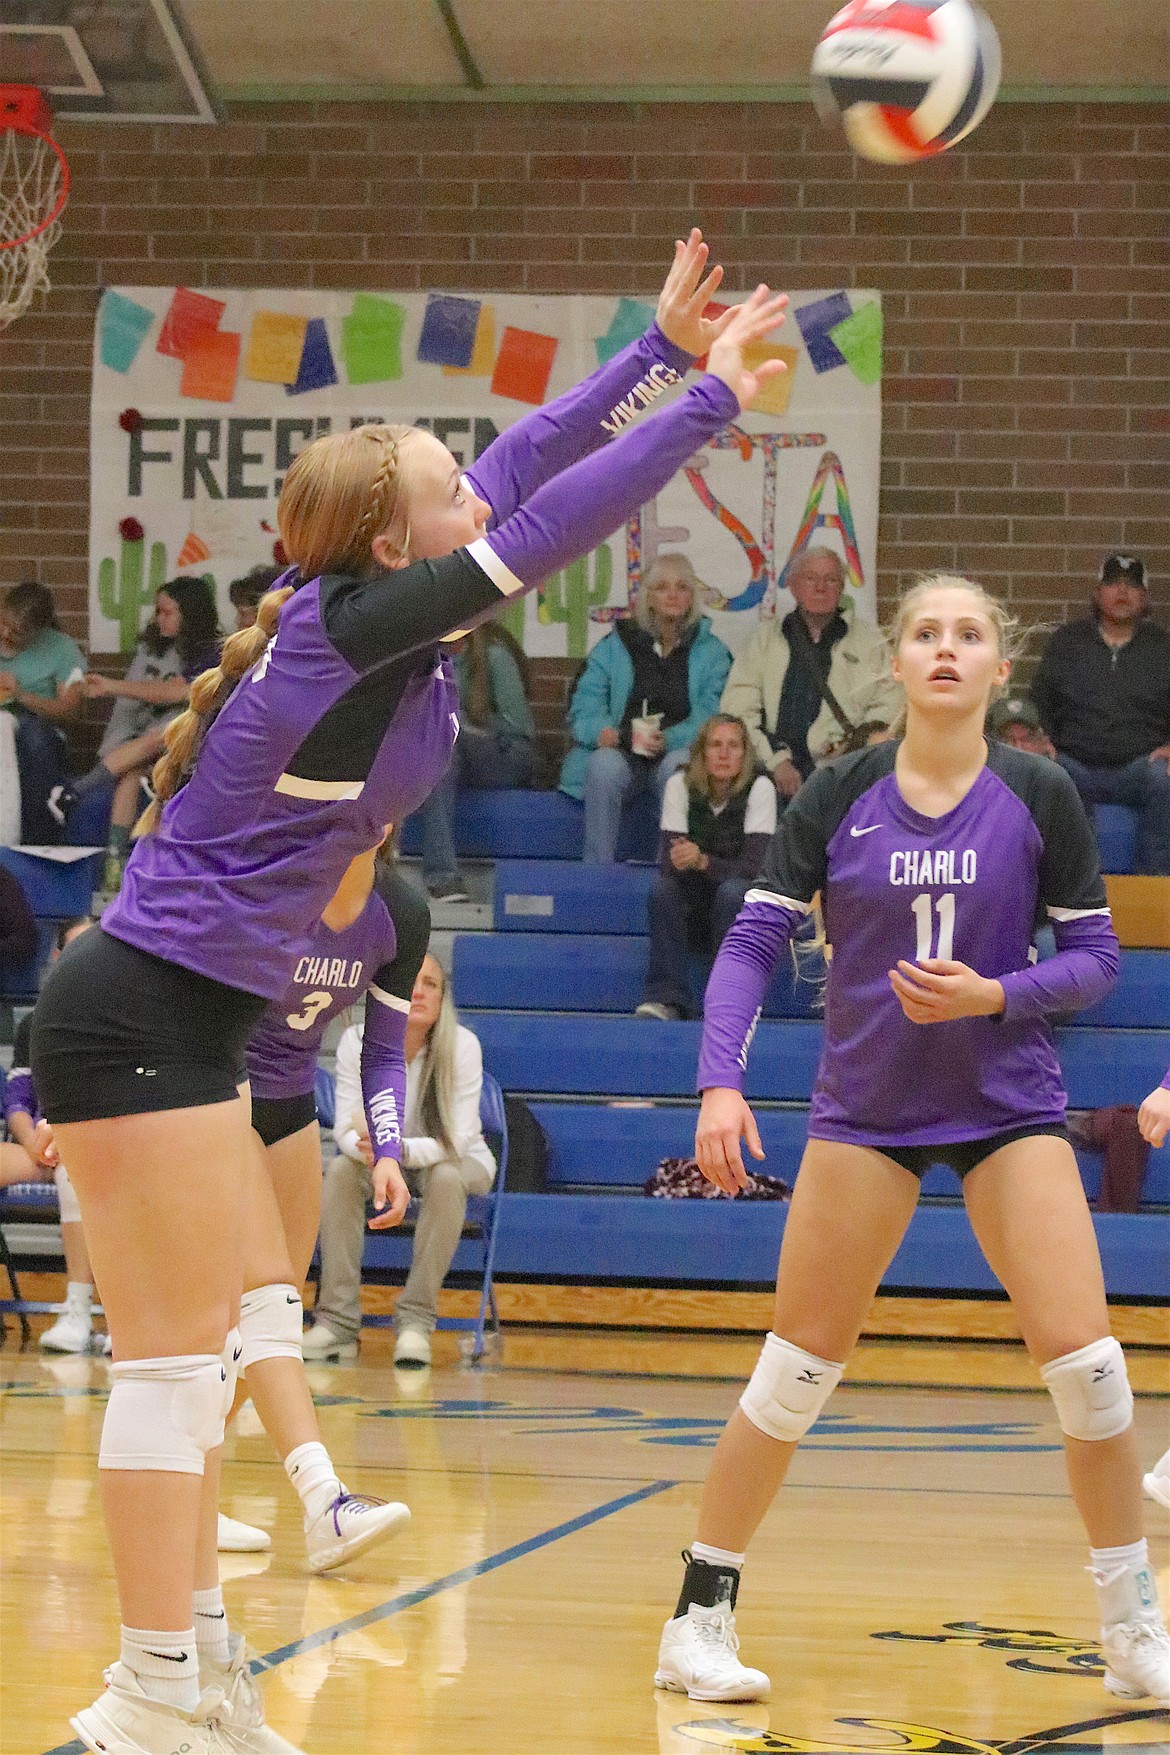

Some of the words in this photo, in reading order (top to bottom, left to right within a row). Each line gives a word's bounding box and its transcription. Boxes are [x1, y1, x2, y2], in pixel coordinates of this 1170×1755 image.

[128, 416, 501, 499] FRESE
[889, 849, 977, 886] CHARLO
[911, 893, 955, 961] 11
[293, 956, 363, 988] CHARLO
[286, 991, 333, 1030] 3
